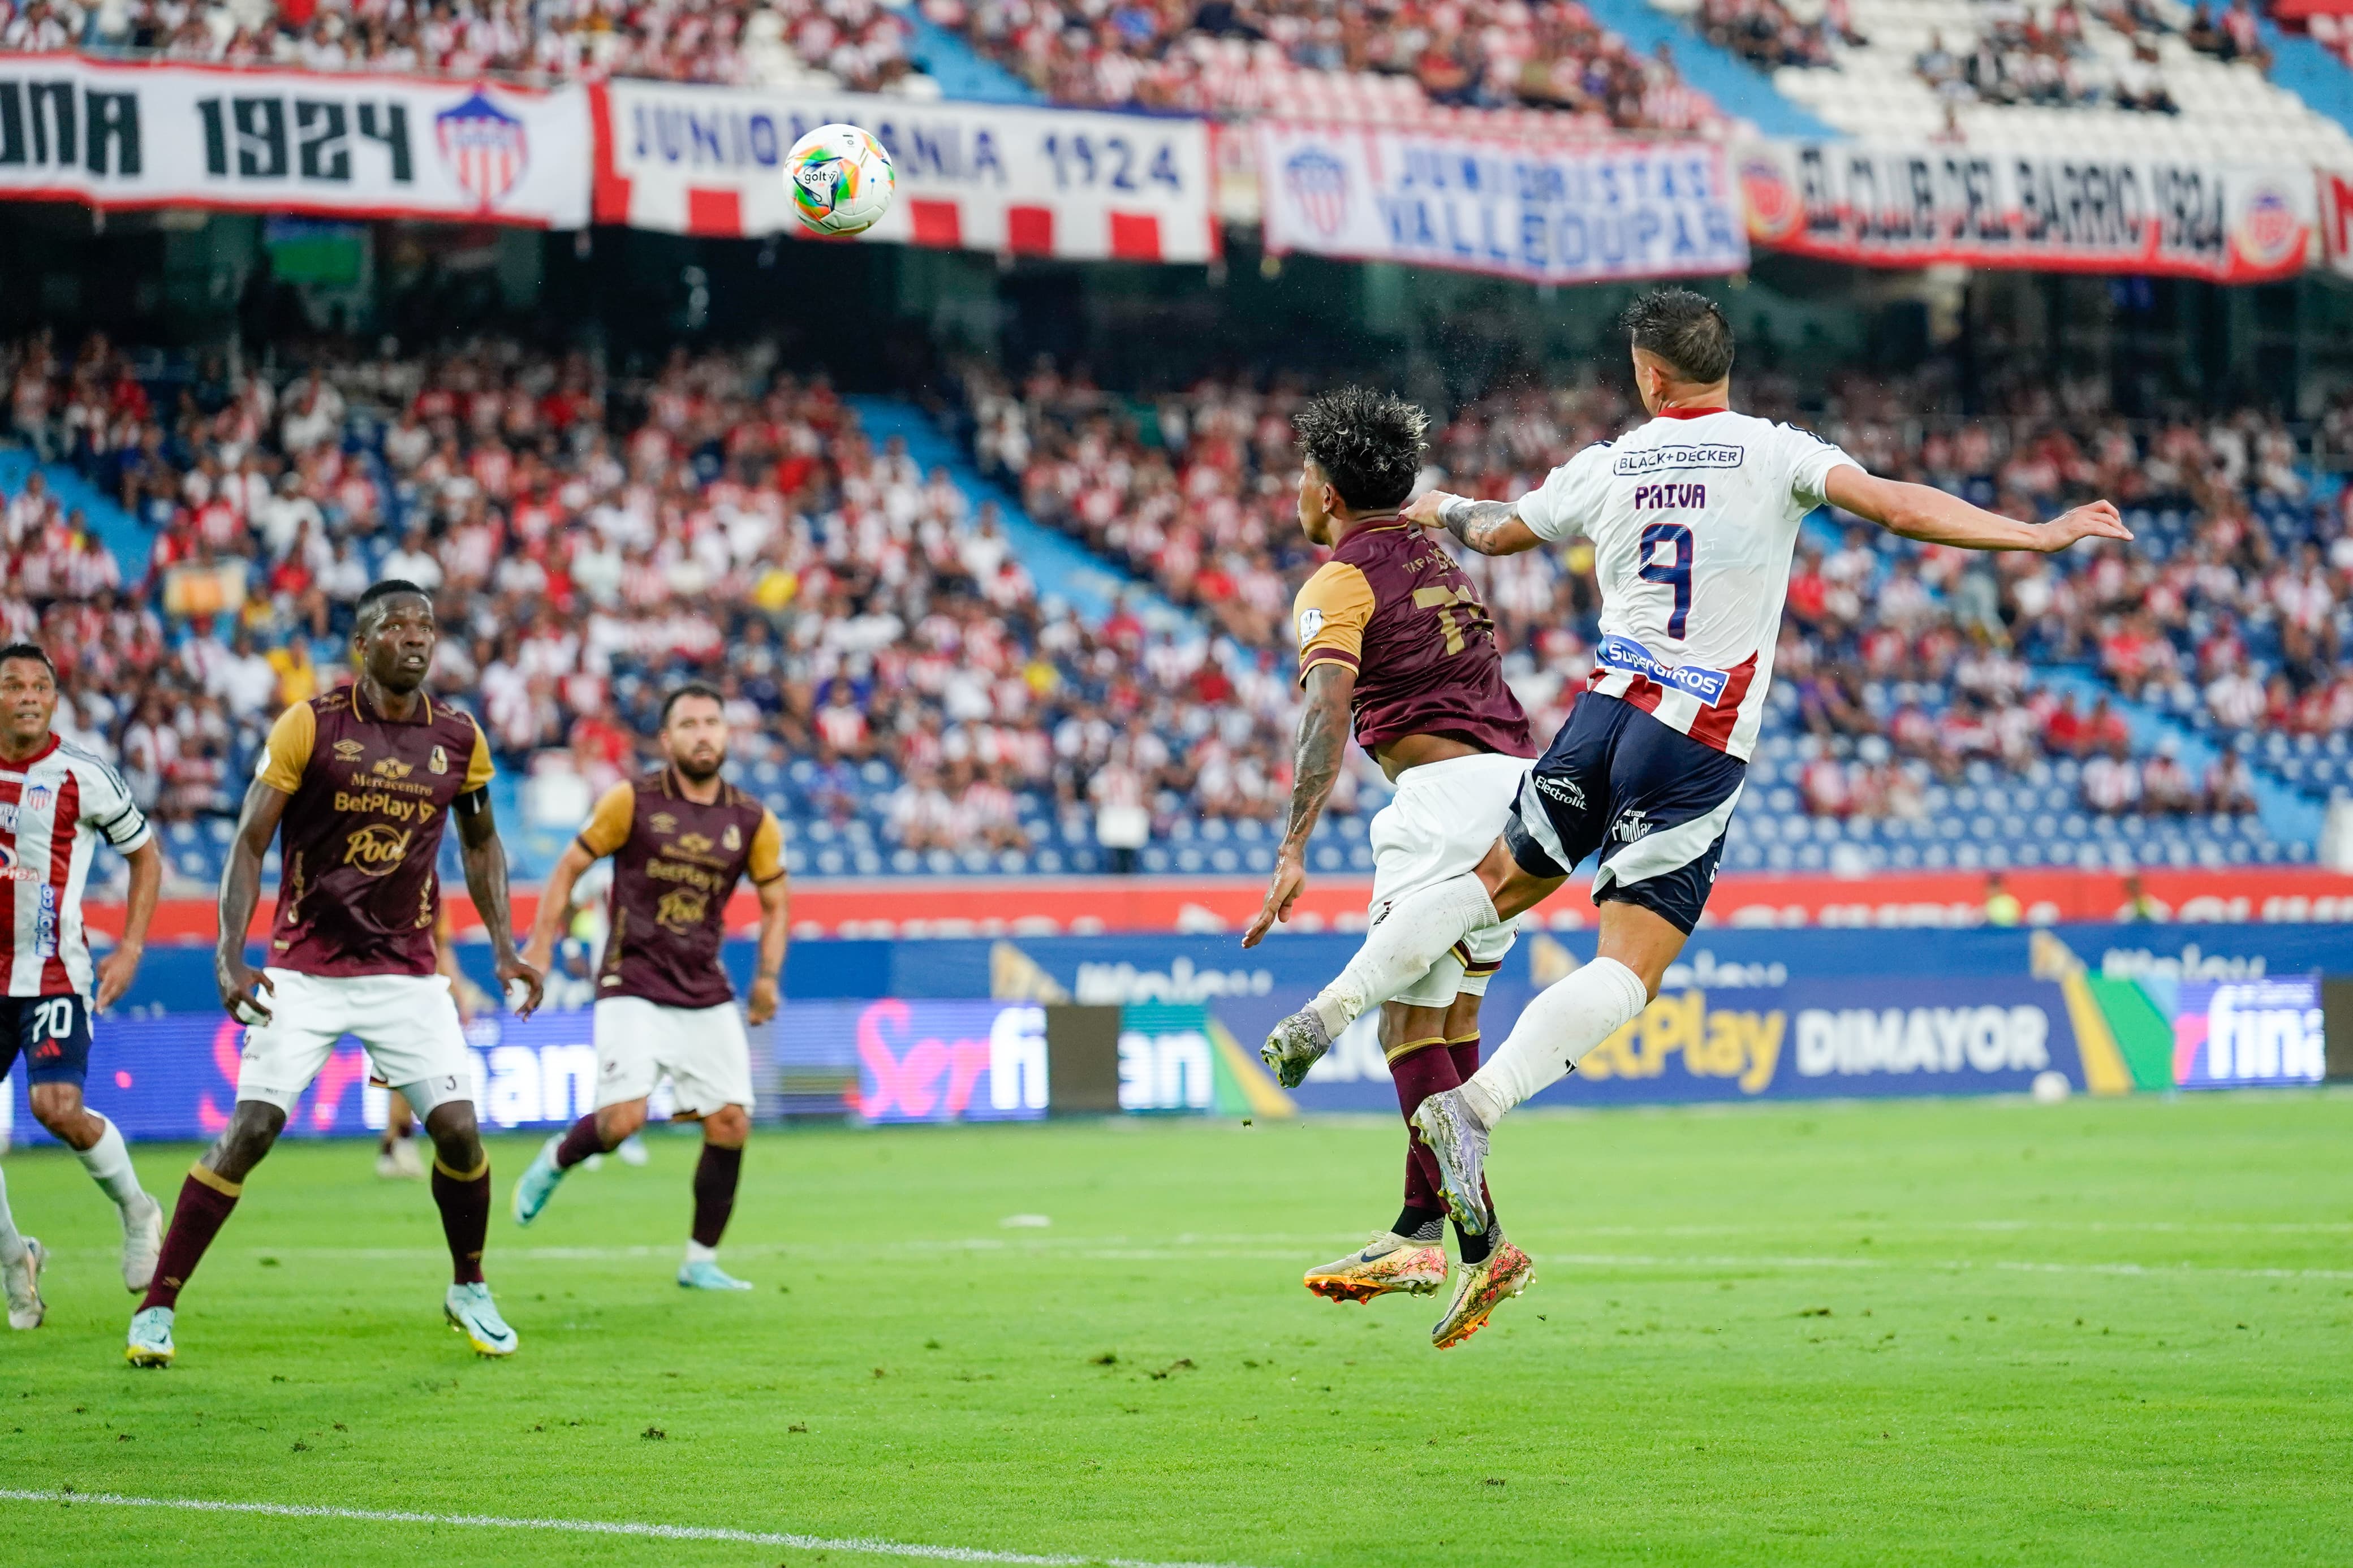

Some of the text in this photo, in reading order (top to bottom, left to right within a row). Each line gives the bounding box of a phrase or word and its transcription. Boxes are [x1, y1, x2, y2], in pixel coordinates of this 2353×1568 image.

[198, 92, 413, 182] 1924
[631, 102, 1183, 193] JUNIOANIA 1924
[1619, 451, 1738, 470] BLACK+DECKER
[1635, 484, 1705, 510] PAIVA
[1638, 523, 1693, 641] 9
[351, 772, 433, 797] Mercacentro
[1535, 775, 1587, 810] Electrolit
[335, 793, 415, 822] BetPlay
[33, 998, 72, 1043] 70
[1795, 1004, 2050, 1077] DIMAYOR
